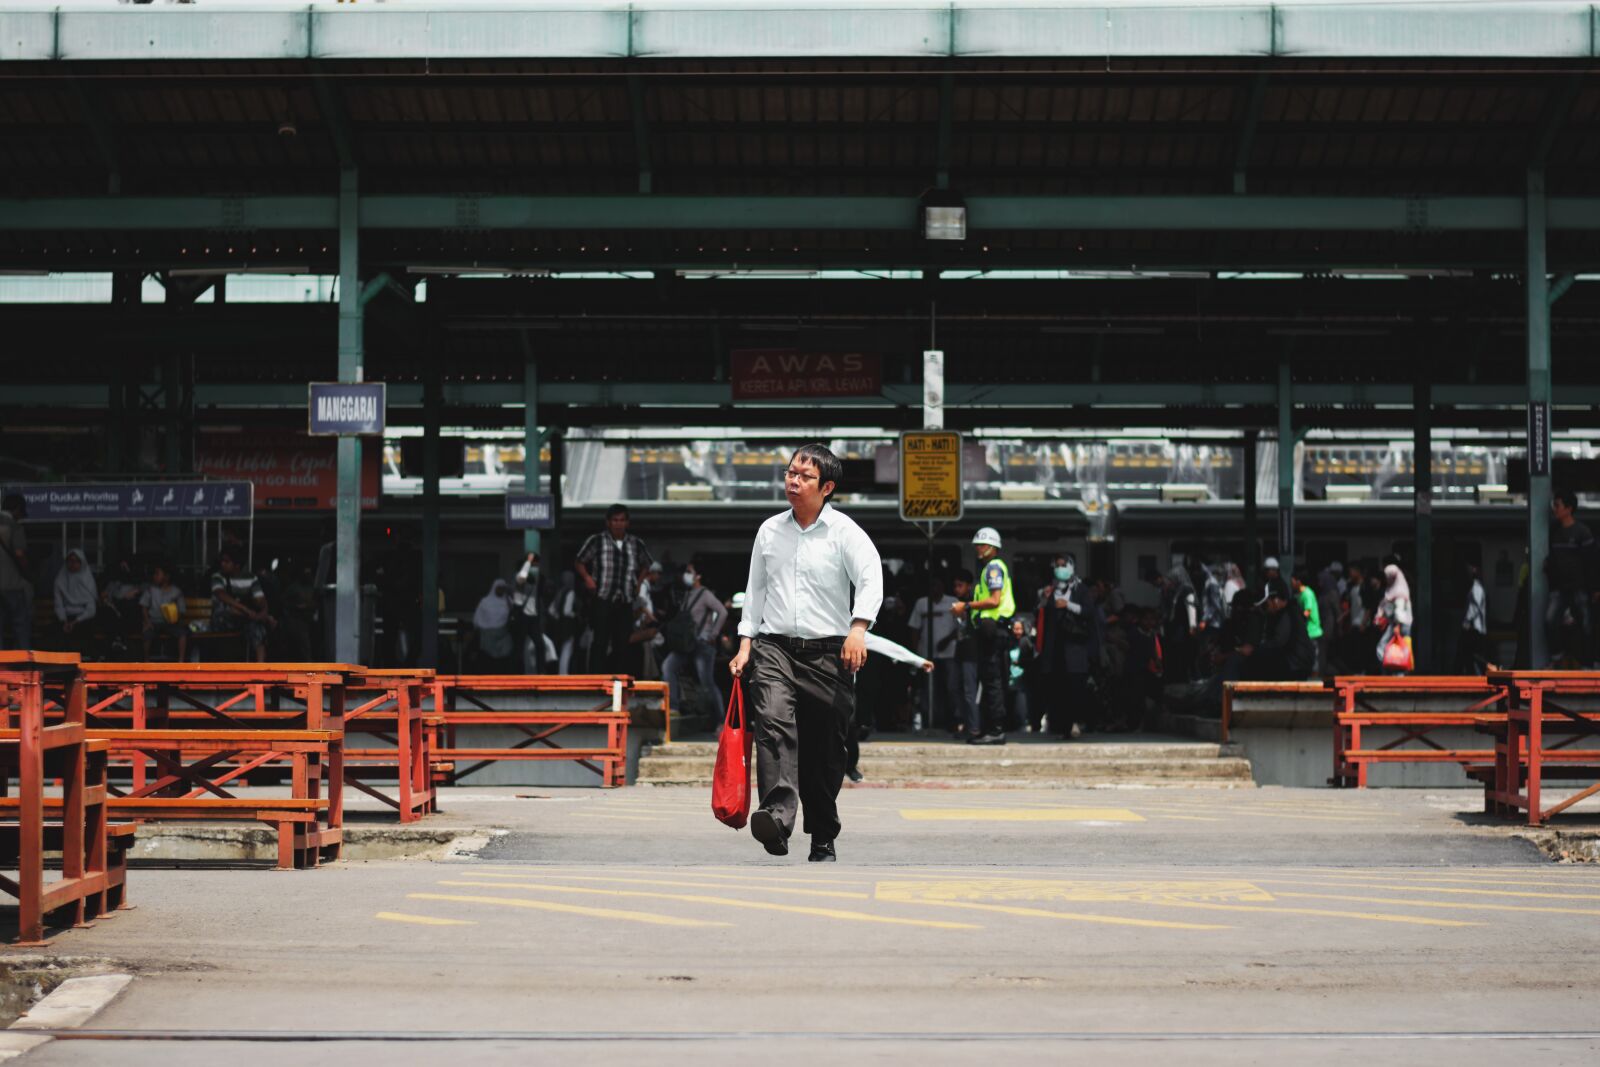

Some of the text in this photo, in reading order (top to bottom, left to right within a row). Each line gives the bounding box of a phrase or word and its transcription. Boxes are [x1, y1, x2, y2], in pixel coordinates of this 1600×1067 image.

[751, 353, 864, 374] AWAS
[739, 378, 783, 393] KERETA
[834, 376, 873, 391] LEWAT
[317, 395, 377, 422] MANGGARAI
[907, 439, 925, 450] HATI
[931, 439, 950, 450] HATI
[49, 491, 81, 502] Duduk
[82, 491, 119, 502] Prioritas
[511, 503, 550, 520] MANGGARAI
